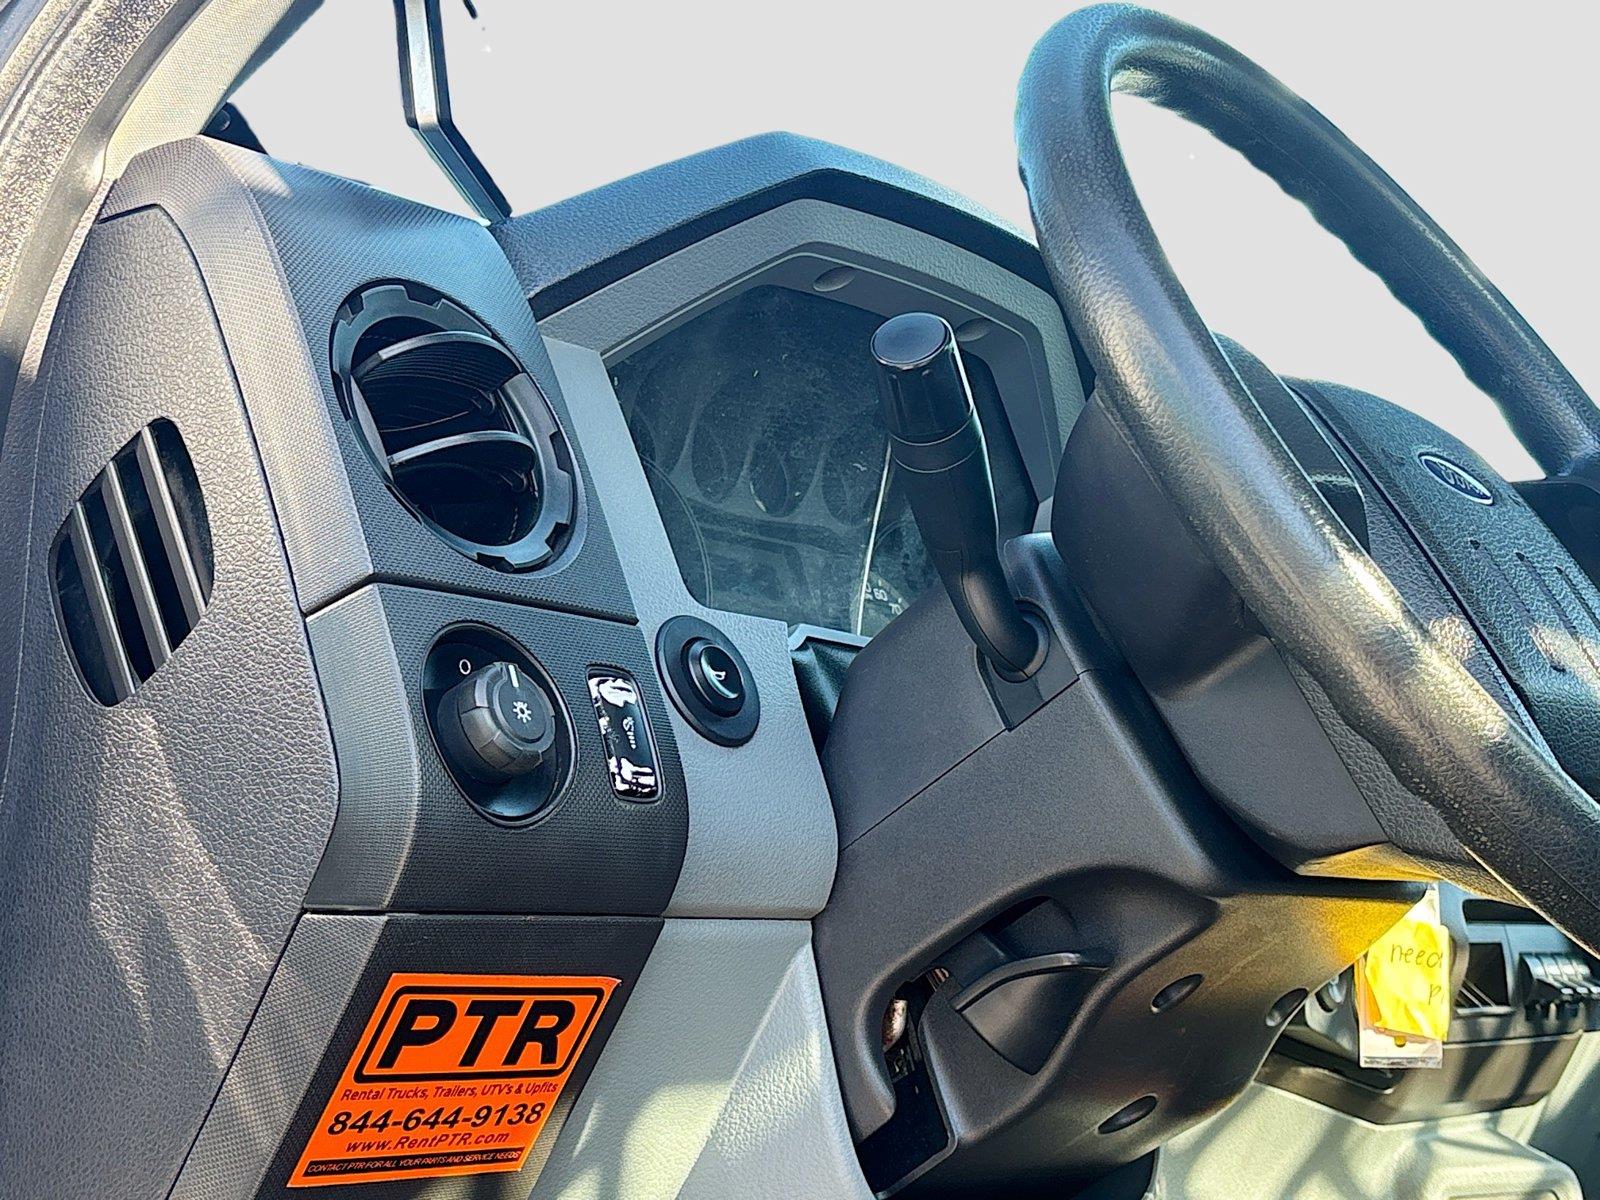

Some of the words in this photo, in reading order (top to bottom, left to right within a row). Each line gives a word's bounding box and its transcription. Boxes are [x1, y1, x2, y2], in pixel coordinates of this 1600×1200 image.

[873, 588, 888, 602] 60
[888, 602, 904, 616] 70
[375, 998, 576, 1070] PTR
[340, 1087, 386, 1101] Rental
[387, 1086, 429, 1100] Trucks,
[433, 1085, 478, 1098] Trailers,
[481, 1083, 514, 1096] UTV's
[514, 1083, 524, 1095] &
[525, 1081, 559, 1096] Upfits
[327, 1102, 546, 1135] 844-644-9138
[346, 1132, 510, 1153] www.RentPTR.com
[307, 1162, 347, 1173] CONTACT
[347, 1161, 366, 1170] PTR
[365, 1160, 384, 1169] FOR
[382, 1160, 397, 1168] ALL
[399, 1158, 421, 1167] YOUR
[420, 1156, 447, 1165] PARTS
[446, 1155, 463, 1163] AND
[463, 1152, 495, 1162] SERVICE
[494, 1151, 521, 1160] NEEDS
